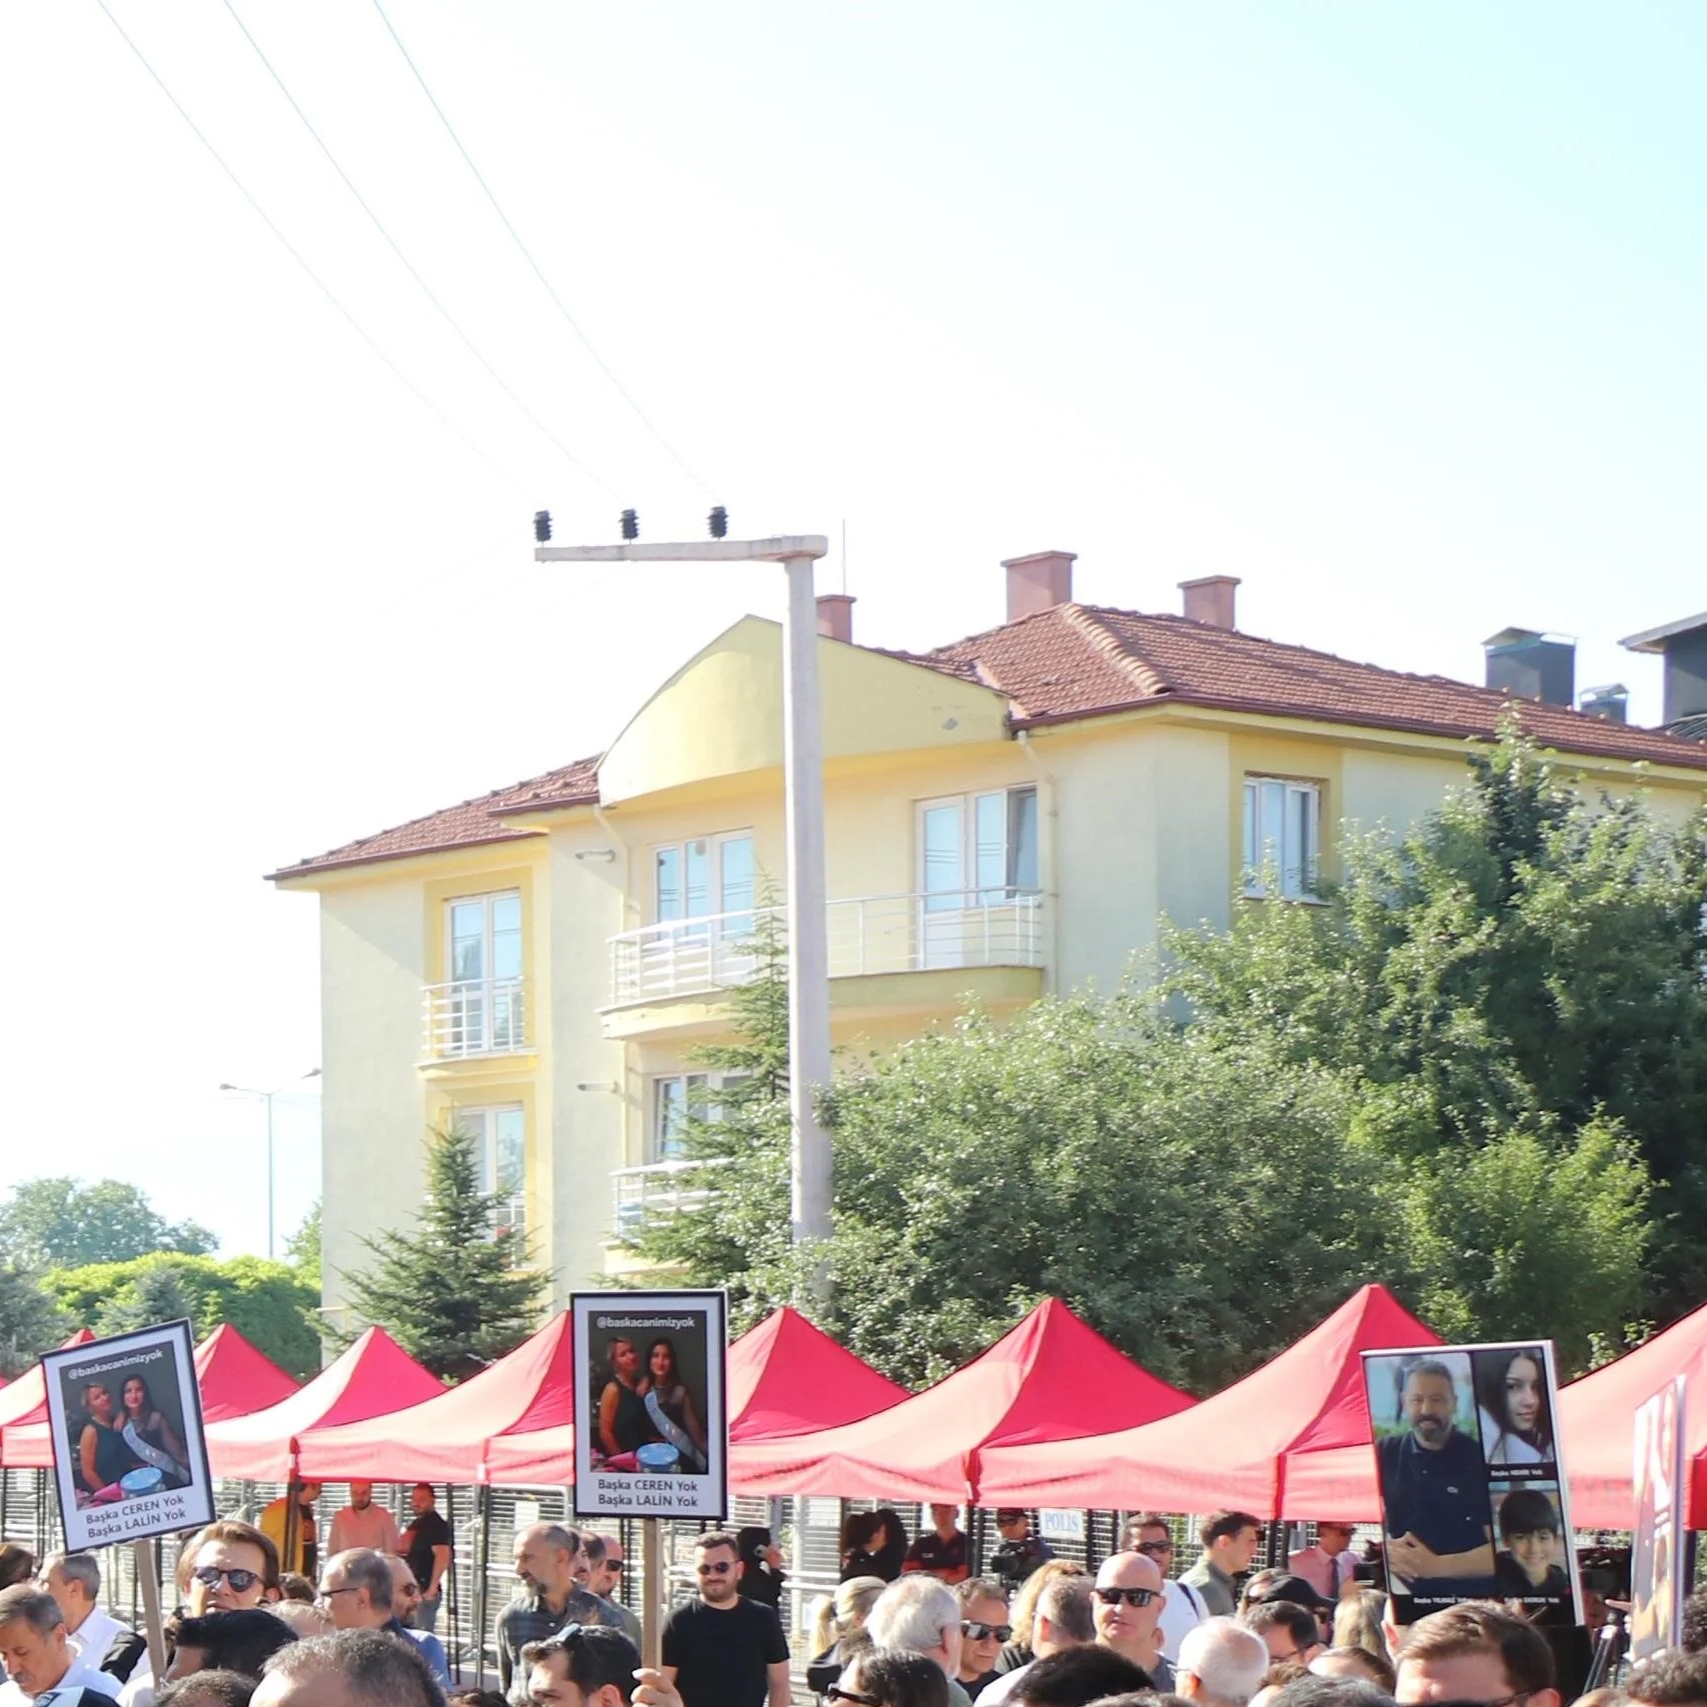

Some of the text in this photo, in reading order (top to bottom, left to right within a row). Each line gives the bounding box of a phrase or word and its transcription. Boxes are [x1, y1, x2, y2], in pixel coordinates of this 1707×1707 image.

[596, 1316, 695, 1330] @baskacanimizyok
[68, 1349, 163, 1381] @baskacanimizyok
[598, 1478, 698, 1493] Başka CEREN Yok
[86, 1493, 185, 1526] Başka CEREN Yok
[598, 1493, 632, 1508] Başka
[676, 1494, 698, 1507] Yok
[87, 1508, 186, 1540] Başka LALİN Yok
